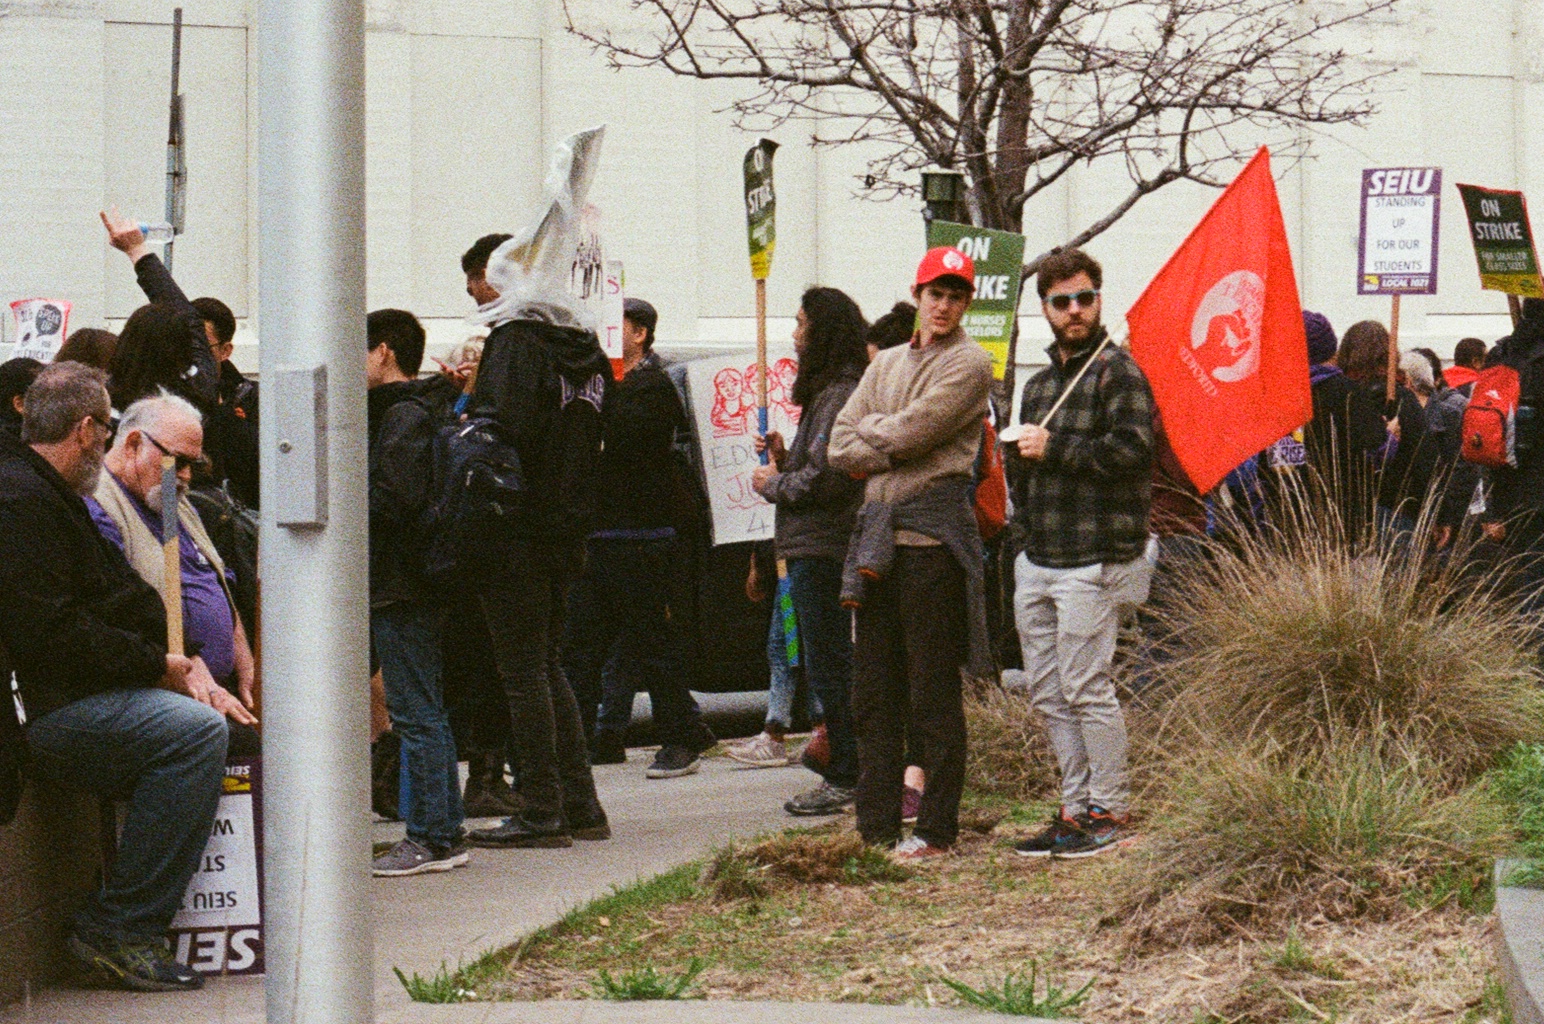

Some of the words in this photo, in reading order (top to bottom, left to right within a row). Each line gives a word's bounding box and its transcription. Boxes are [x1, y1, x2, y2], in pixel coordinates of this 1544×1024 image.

[1368, 170, 1433, 195] SEIU
[1375, 197, 1425, 208] STANDING
[1481, 199, 1500, 216] ON
[1392, 218, 1405, 228] UP
[1474, 222, 1522, 240] STRIKE
[956, 236, 991, 261] ON
[1376, 239, 1395, 250] FOR
[1398, 239, 1419, 250] OUR
[1374, 260, 1422, 271] STUDENTS
[973, 275, 1009, 300] IKE
[1382, 278, 1407, 287] LOCAL
[202, 855, 226, 872] ST
[193, 890, 238, 910] SEIU
[168, 929, 260, 972] SEI
